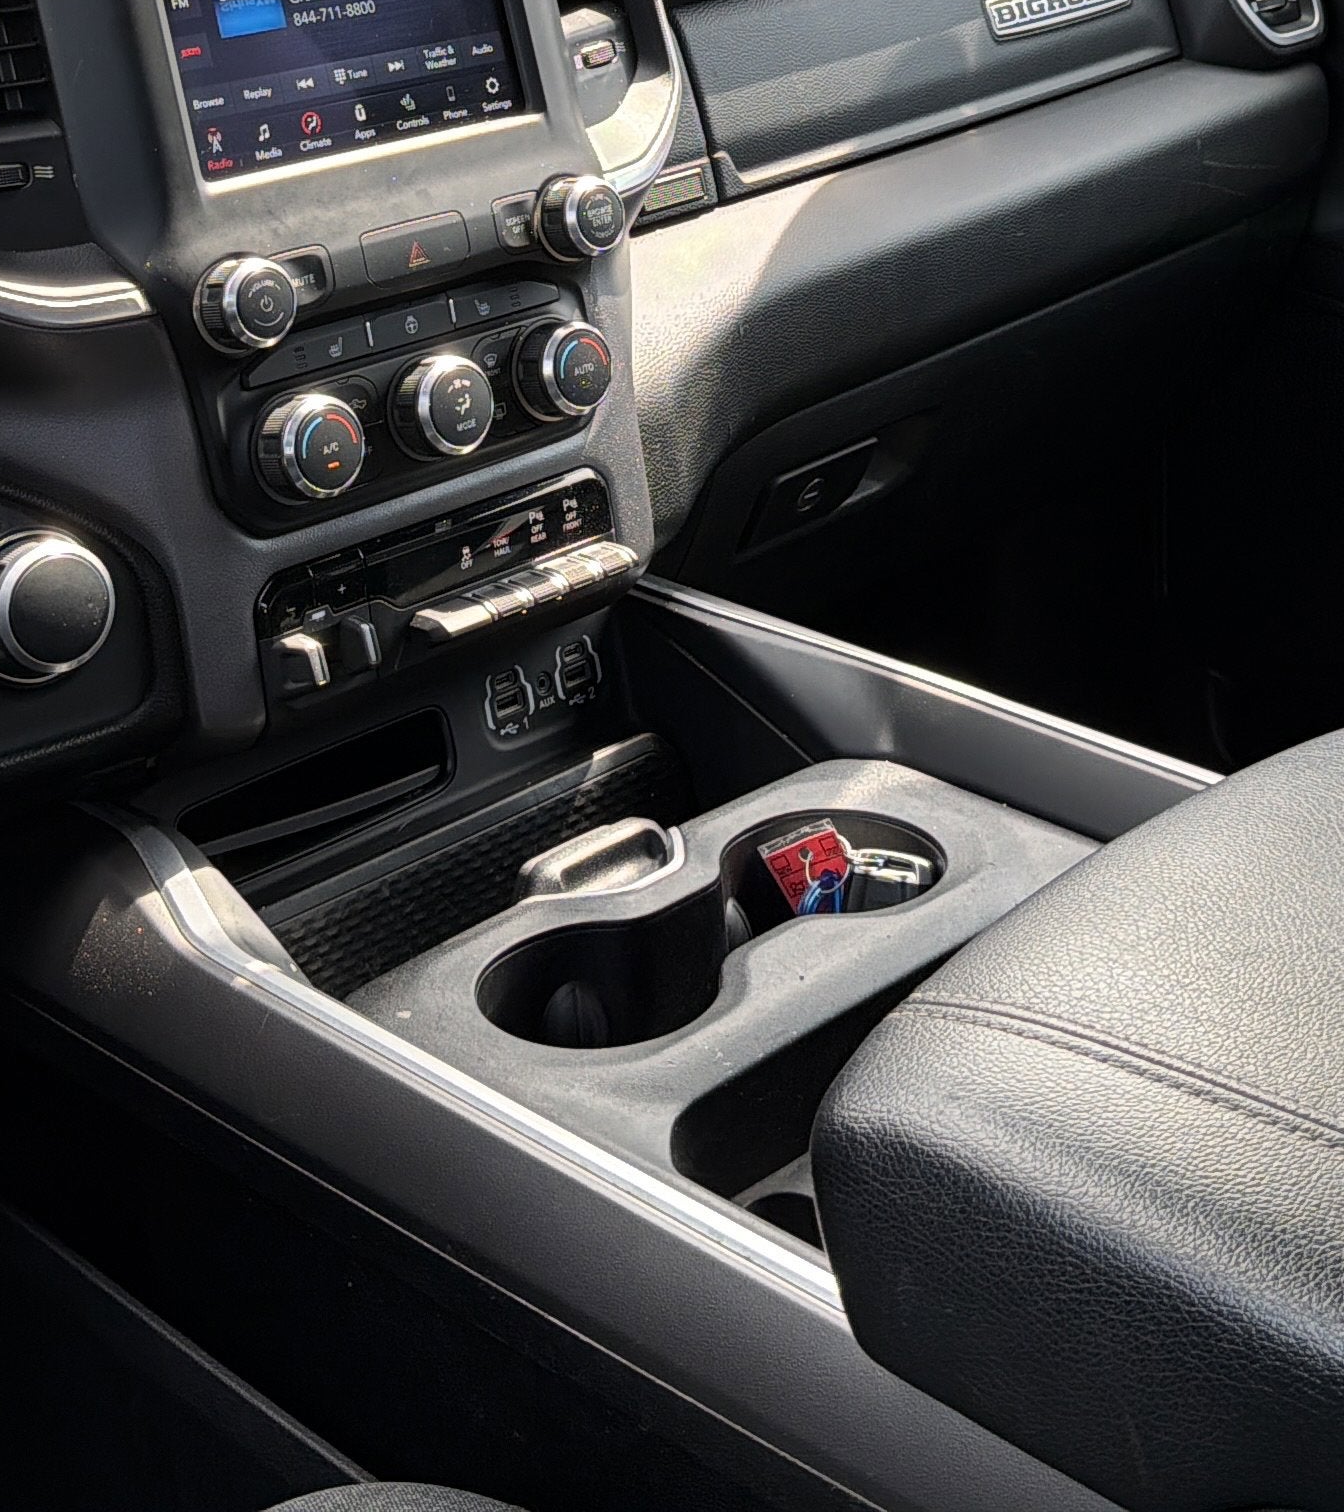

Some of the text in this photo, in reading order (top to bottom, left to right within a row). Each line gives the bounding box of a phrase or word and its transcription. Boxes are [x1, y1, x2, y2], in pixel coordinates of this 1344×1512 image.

[293, 0, 376, 27] 844-711-8800
[422, 47, 447, 59] Traffic
[471, 43, 494, 56] Audio
[424, 57, 457, 71] Weather
[348, 69, 368, 80] Tune
[243, 87, 273, 101] Replay
[192, 96, 225, 111] Browse
[481, 99, 513, 113] Settings
[396, 115, 430, 131] Controls
[355, 127, 376, 141] Apps
[299, 137, 333, 152] Climate
[255, 147, 283, 162] Media
[207, 159, 234, 171] Radio
[291, 273, 316, 288] MUTE
[573, 362, 596, 377] AUTO
[456, 417, 477, 432] MODE
[322, 441, 339, 456] A/C
[565, 510, 577, 522] OFF
[531, 523, 544, 535] OFF
[562, 518, 583, 533] FRONT
[460, 558, 474, 570] OFF
[539, 694, 556, 710] AUX
